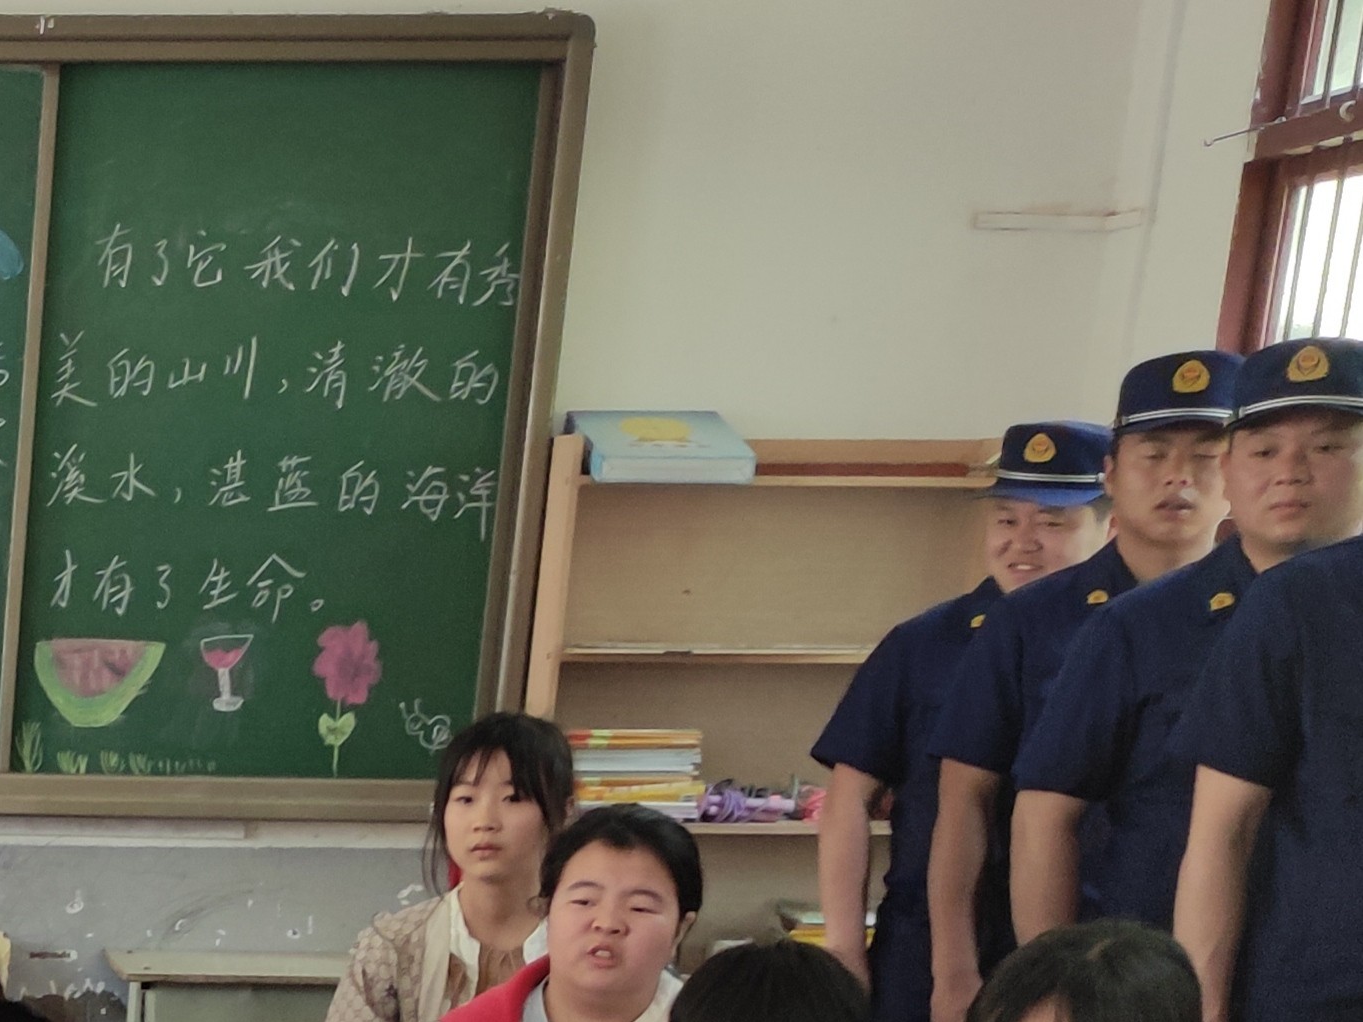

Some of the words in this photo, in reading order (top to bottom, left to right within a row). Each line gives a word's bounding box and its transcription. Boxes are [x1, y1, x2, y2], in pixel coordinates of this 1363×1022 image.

[94, 223, 522, 307] 有了它我们才有秀
[50, 550, 324, 624] 才有了生命。
